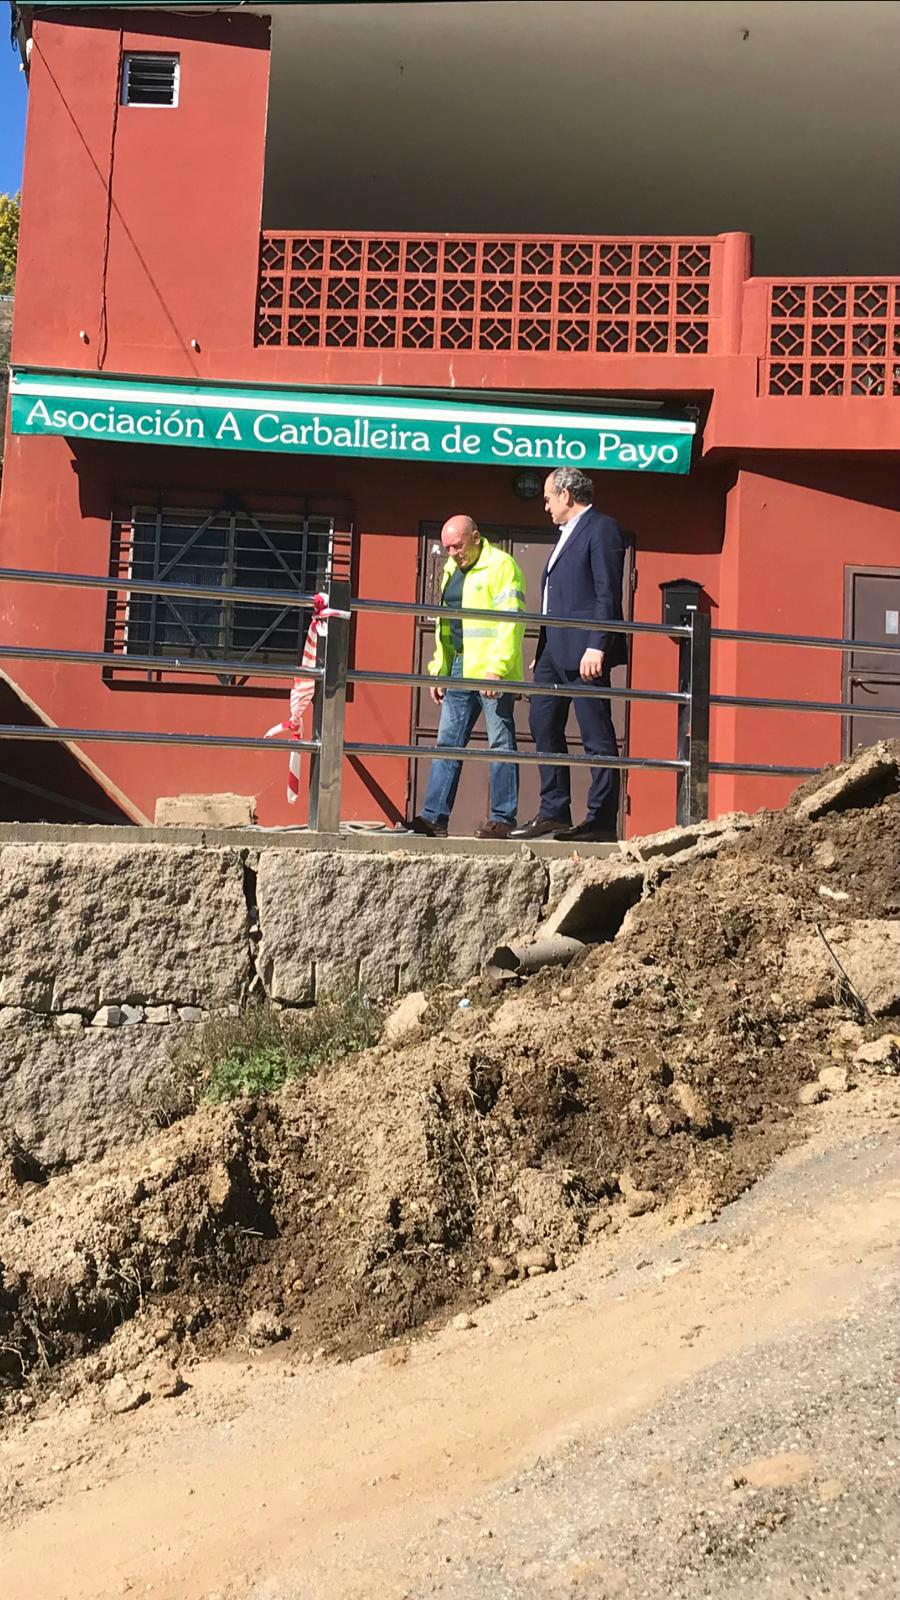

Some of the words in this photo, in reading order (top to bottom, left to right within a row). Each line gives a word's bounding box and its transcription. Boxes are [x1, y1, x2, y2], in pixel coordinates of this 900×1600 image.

[26, 399, 204, 438] Asociación
[216, 412, 241, 440] A
[253, 413, 430, 451] Carballeira
[441, 425, 481, 454] de
[491, 427, 586, 460] Santo
[598, 433, 679, 468] Payo
